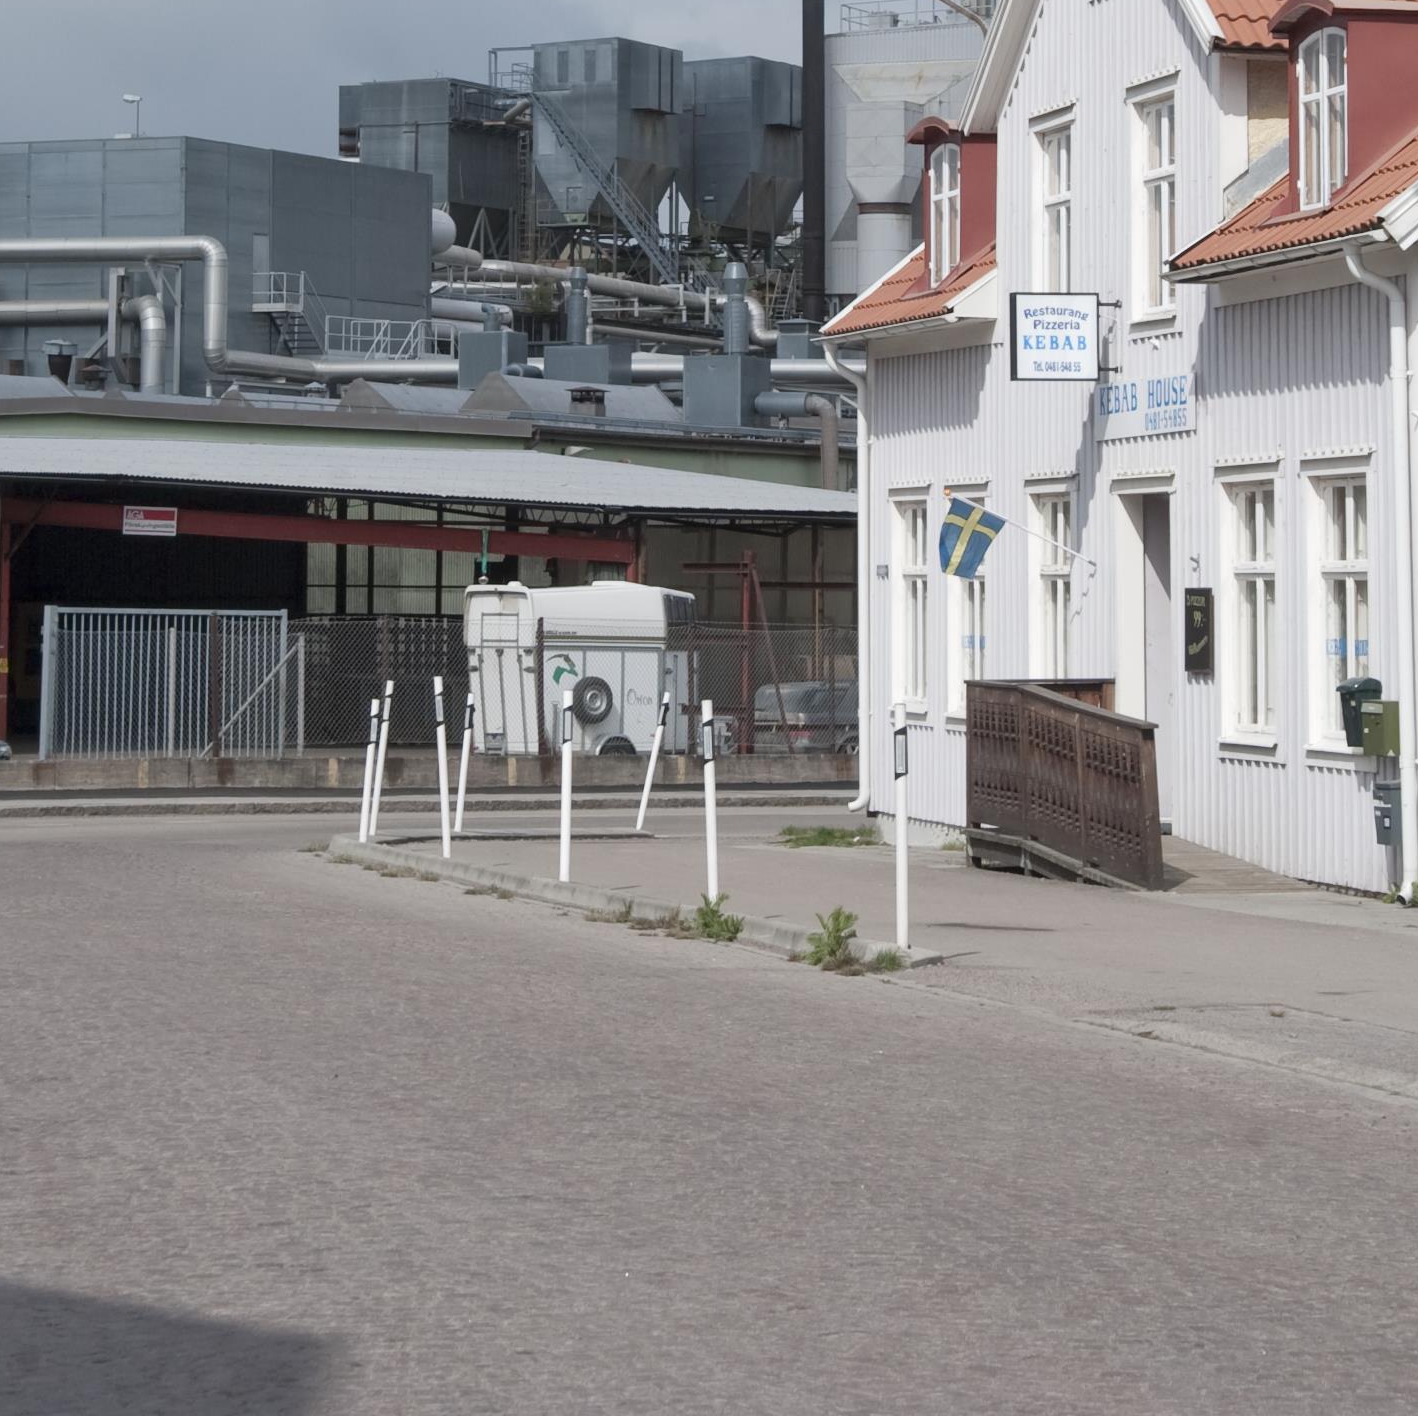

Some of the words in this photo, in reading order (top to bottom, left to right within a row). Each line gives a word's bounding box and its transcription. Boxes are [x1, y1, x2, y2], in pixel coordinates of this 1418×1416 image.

[1023, 306, 1089, 321] Restaurang
[1033, 319, 1081, 330] Pizzeria
[1023, 335, 1087, 350] KEBAB
[1100, 383, 1138, 416] KEBAB
[1147, 375, 1187, 409] HOUSE
